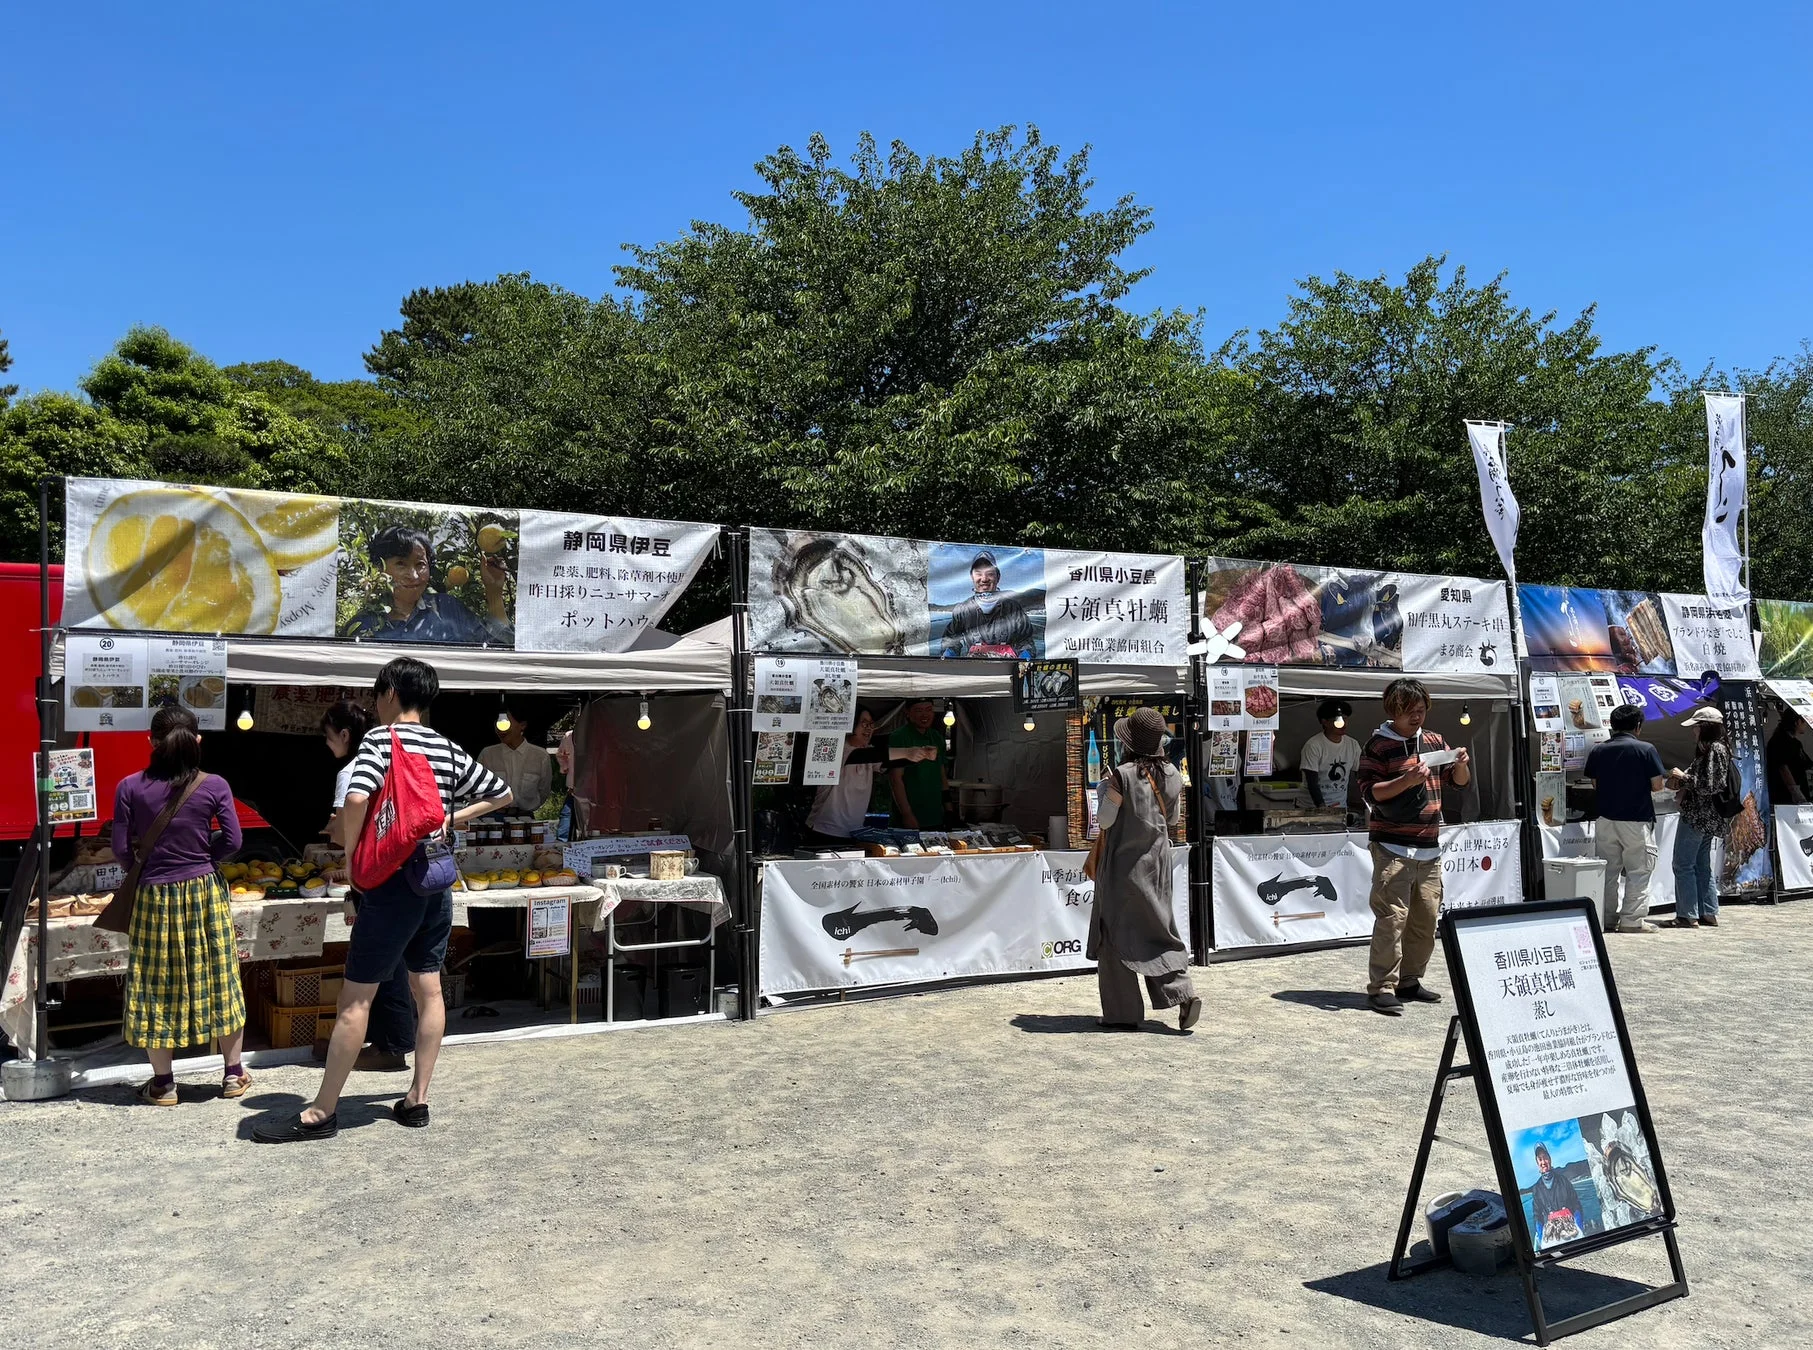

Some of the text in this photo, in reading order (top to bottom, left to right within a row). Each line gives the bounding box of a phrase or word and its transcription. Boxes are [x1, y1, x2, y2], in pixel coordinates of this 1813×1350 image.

[564, 531, 672, 557] 静岡県伊豆
[1068, 565, 1157, 585] 香川県小豆島
[1440, 587, 1472, 603] 愛知県
[1057, 596, 1169, 624] 天領真牡蠣
[1407, 611, 1504, 632] 和牛黒丸ステーキ串
[101, 639, 113, 649] 20
[1063, 637, 1165, 654] 池田漁業協同組合
[1440, 643, 1473, 658] まる商会
[1494, 945, 1567, 970] 香川県小豆島
[1498, 968, 1576, 999] 天領真牡蠣
[1532, 1000, 1556, 1020] 蒸し
